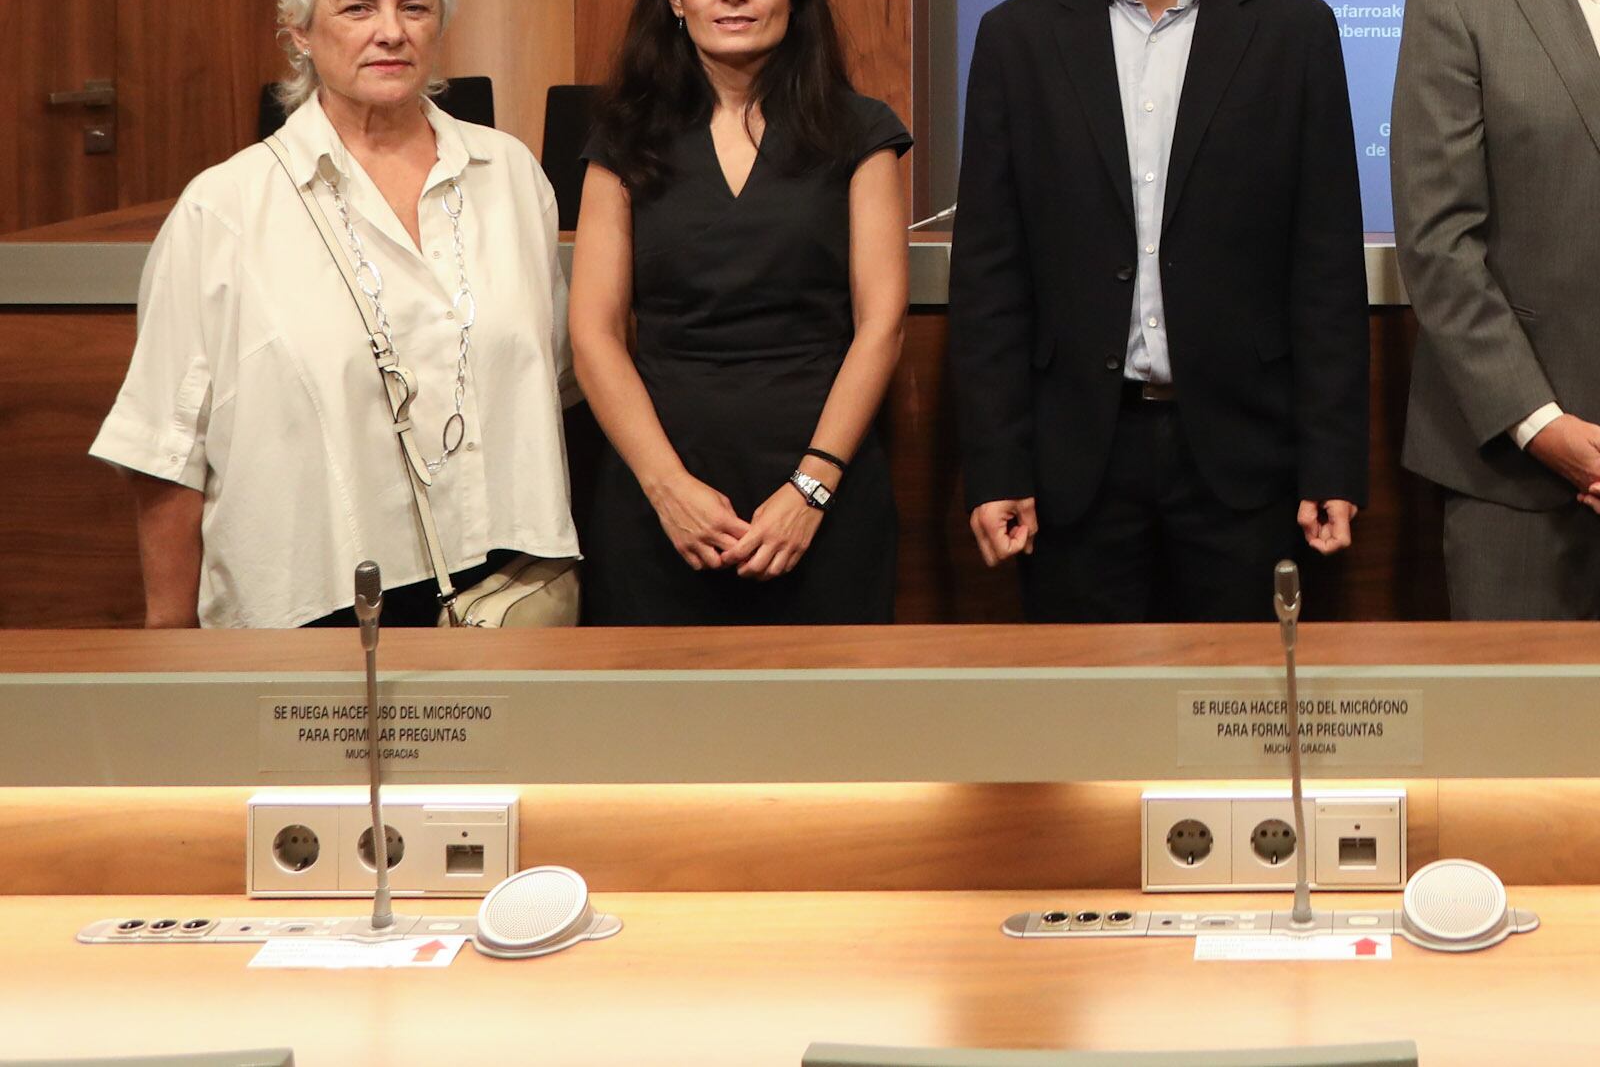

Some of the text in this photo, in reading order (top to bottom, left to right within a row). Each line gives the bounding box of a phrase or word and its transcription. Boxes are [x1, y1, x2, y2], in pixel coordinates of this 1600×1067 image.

[1332, 4, 1403, 19] afarroak
[1365, 143, 1387, 157] de
[274, 705, 288, 720] SE
[291, 705, 329, 720] RUEGA
[400, 705, 420, 720] DEL
[423, 703, 492, 720] MICRÓFONO
[1192, 697, 1408, 715] SE RUEGA HACER SO DEL MICRÓFONO
[299, 727, 467, 742] PARA FORMAR PREGUNTAS
[1217, 722, 1383, 737] PARA FORMUAR PREGUNTAS
[383, 748, 419, 759] GRACIAS
[1300, 743, 1337, 754] GRACIAS
